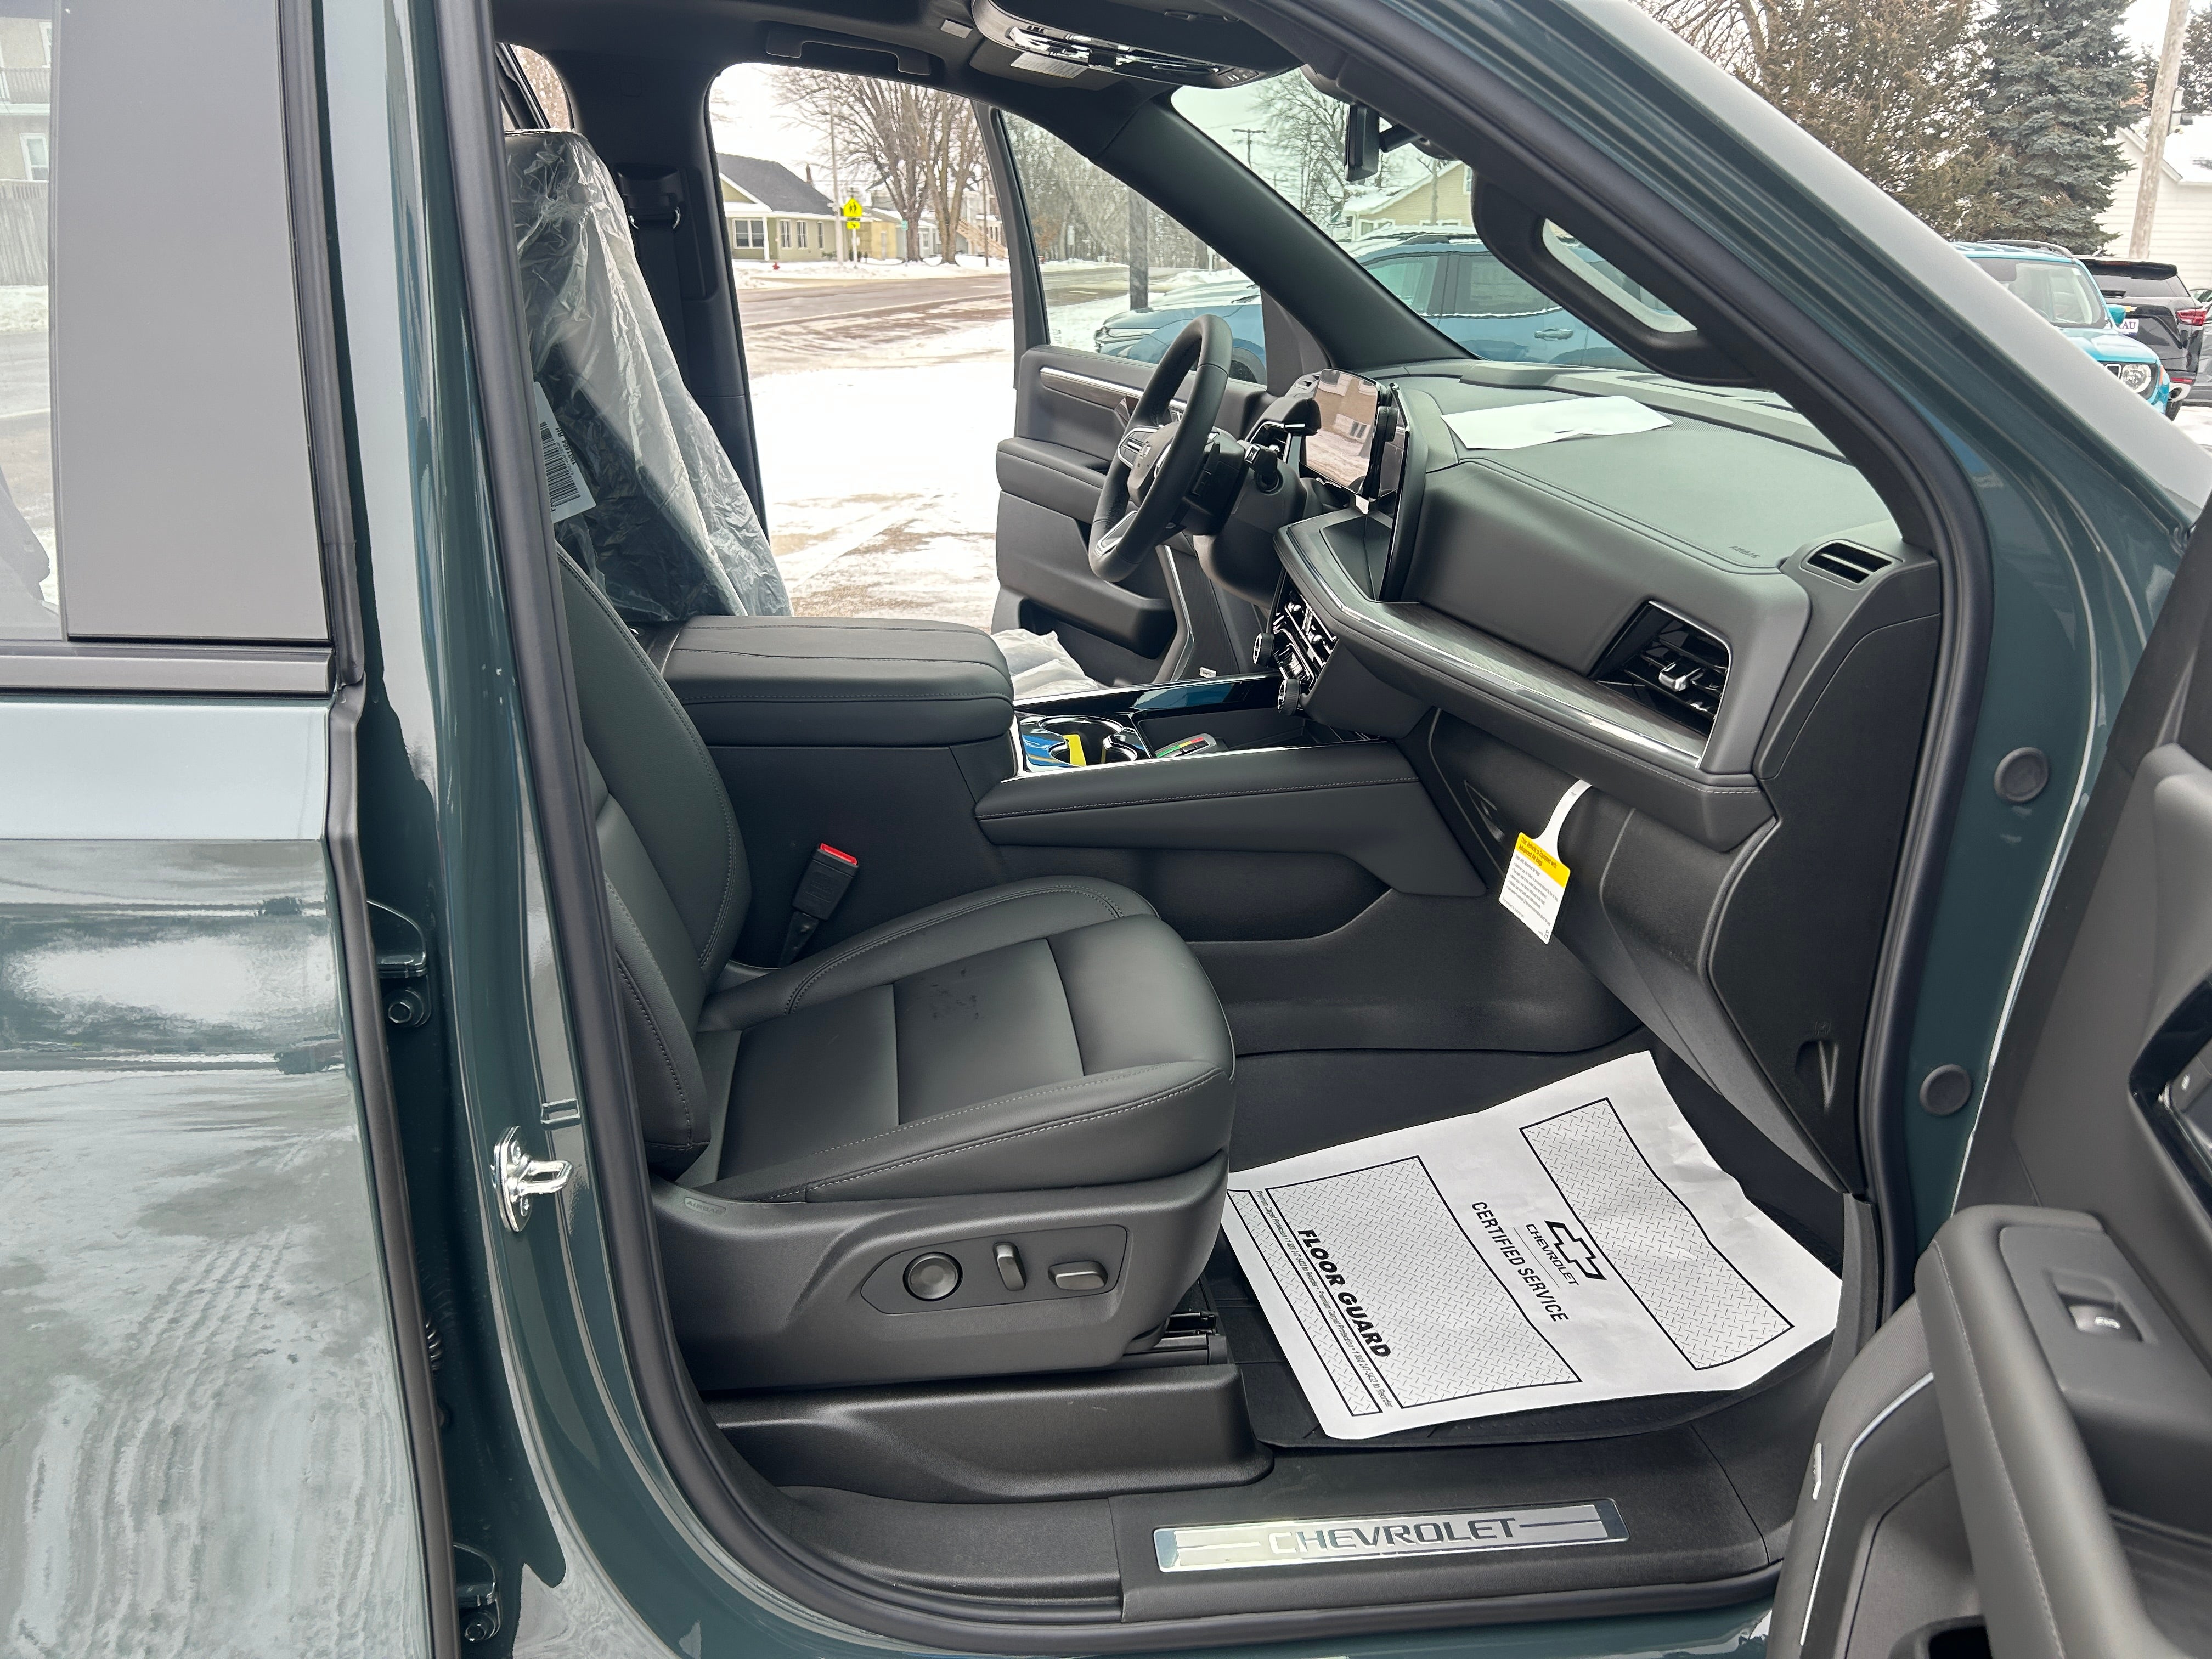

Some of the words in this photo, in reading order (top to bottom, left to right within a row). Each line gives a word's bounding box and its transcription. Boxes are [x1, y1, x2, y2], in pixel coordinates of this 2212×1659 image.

[555, 427, 563, 437] RH
[1728, 546, 1761, 558] AIRBAG
[1471, 1201, 1526, 1266] CERTIFIED
[1517, 1268, 1570, 1322] SERVICE
[1525, 1223, 1579, 1286] CHEVROLET
[1297, 1229, 1346, 1286] FLOOR
[1338, 1291, 1391, 1357] GUARD
[1317, 1290, 1331, 1310] Premium
[1328, 1310, 1341, 1324] Carpet
[1338, 1325, 1354, 1347] Protection
[1376, 1389, 1393, 1408] Reorder
[1269, 1518, 1516, 1554] CHEVROLET
